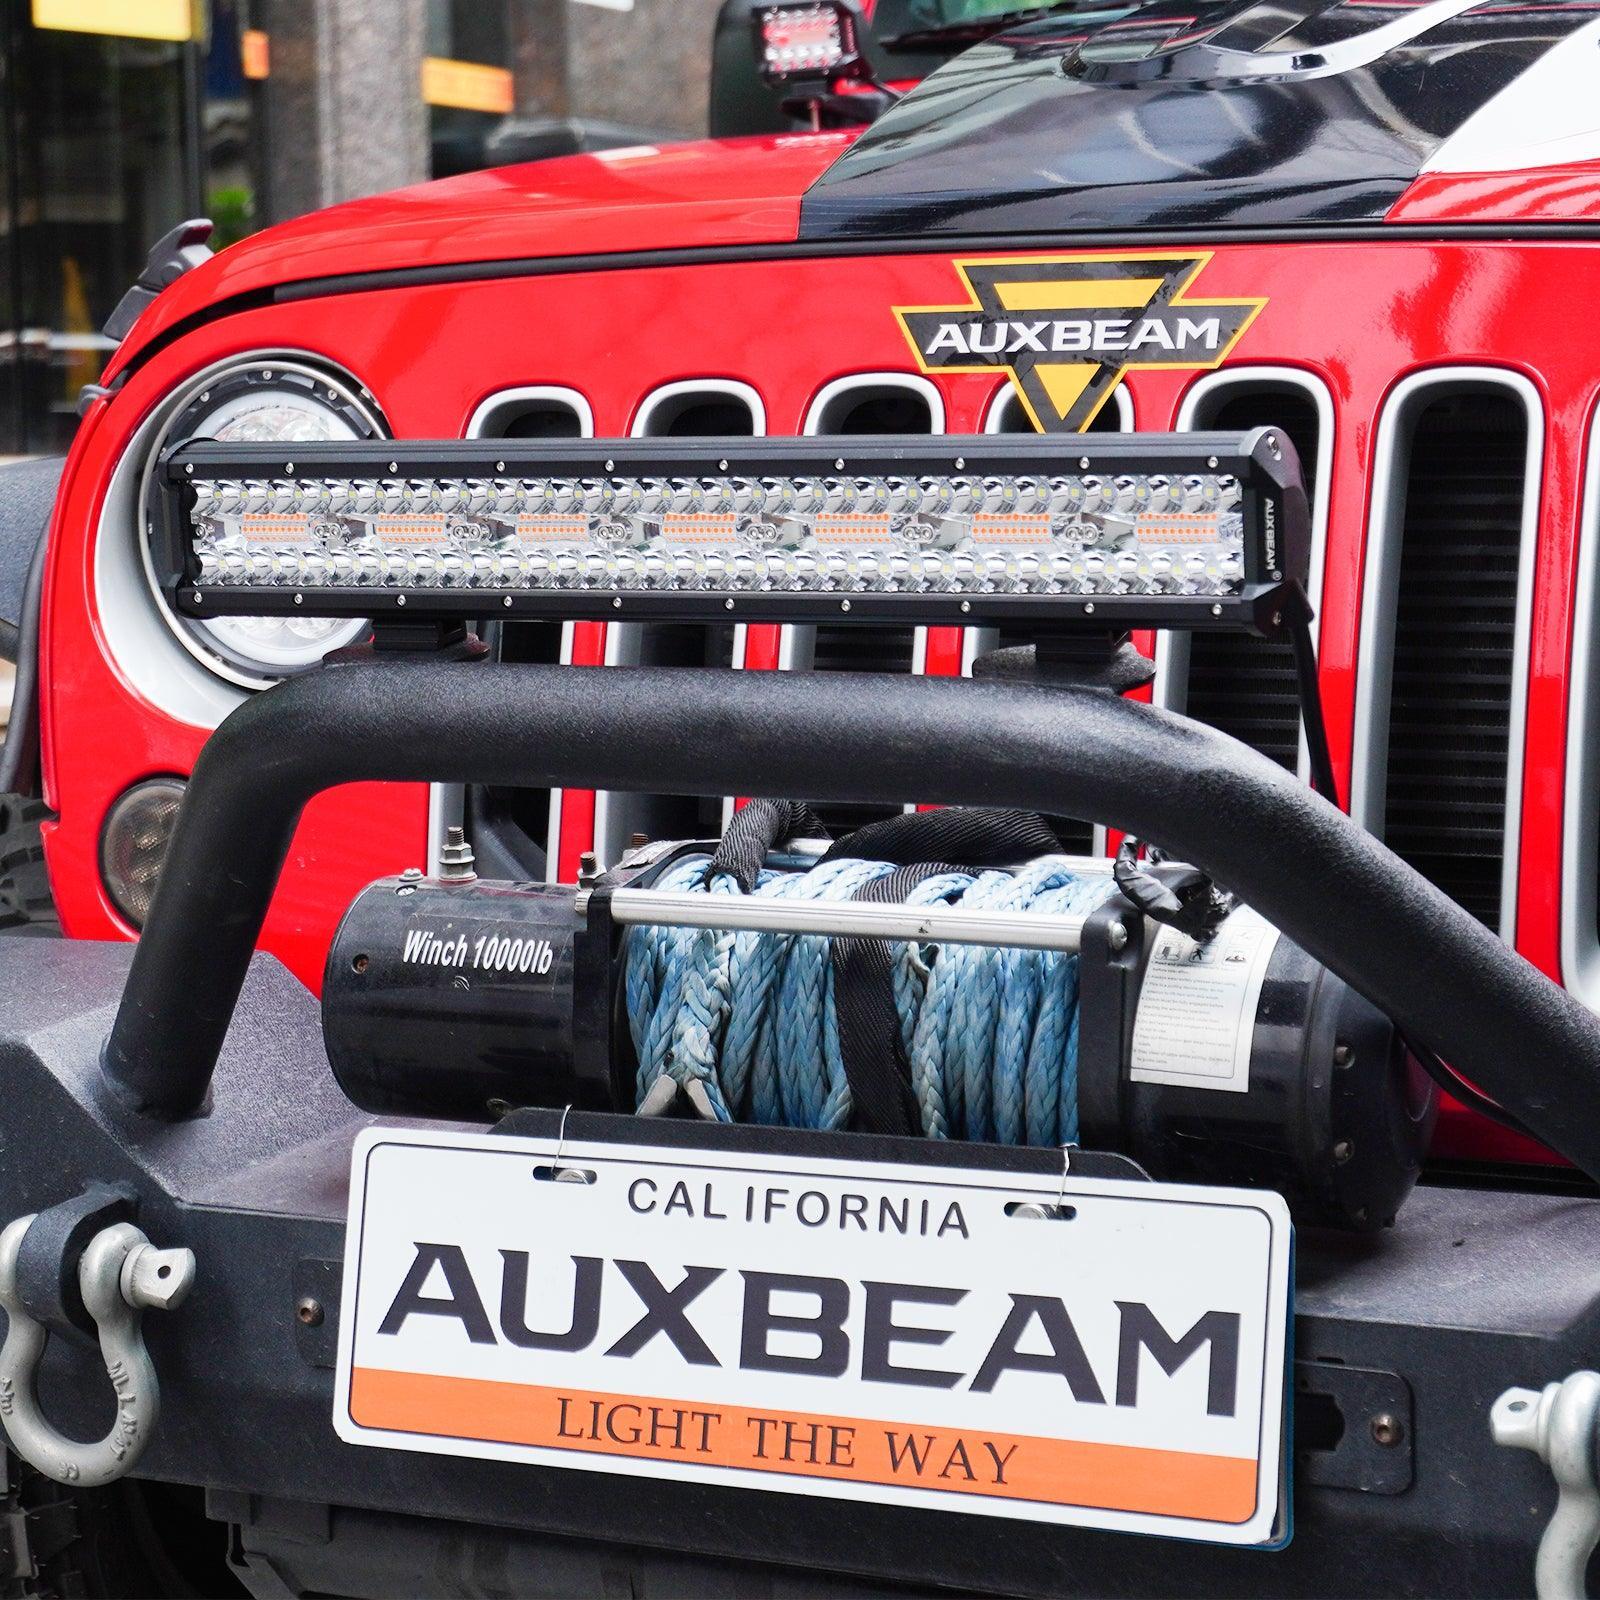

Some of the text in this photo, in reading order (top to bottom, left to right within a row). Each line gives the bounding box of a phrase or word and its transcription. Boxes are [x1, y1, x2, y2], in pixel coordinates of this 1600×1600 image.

[926, 318, 1220, 354] AUXBEAM
[403, 930, 553, 974] Winch 10000lb
[628, 1178, 969, 1239] CALIFORNIA
[376, 1241, 1242, 1417] AUXBEAM
[557, 1397, 1019, 1484] LIGHT THE WAY
